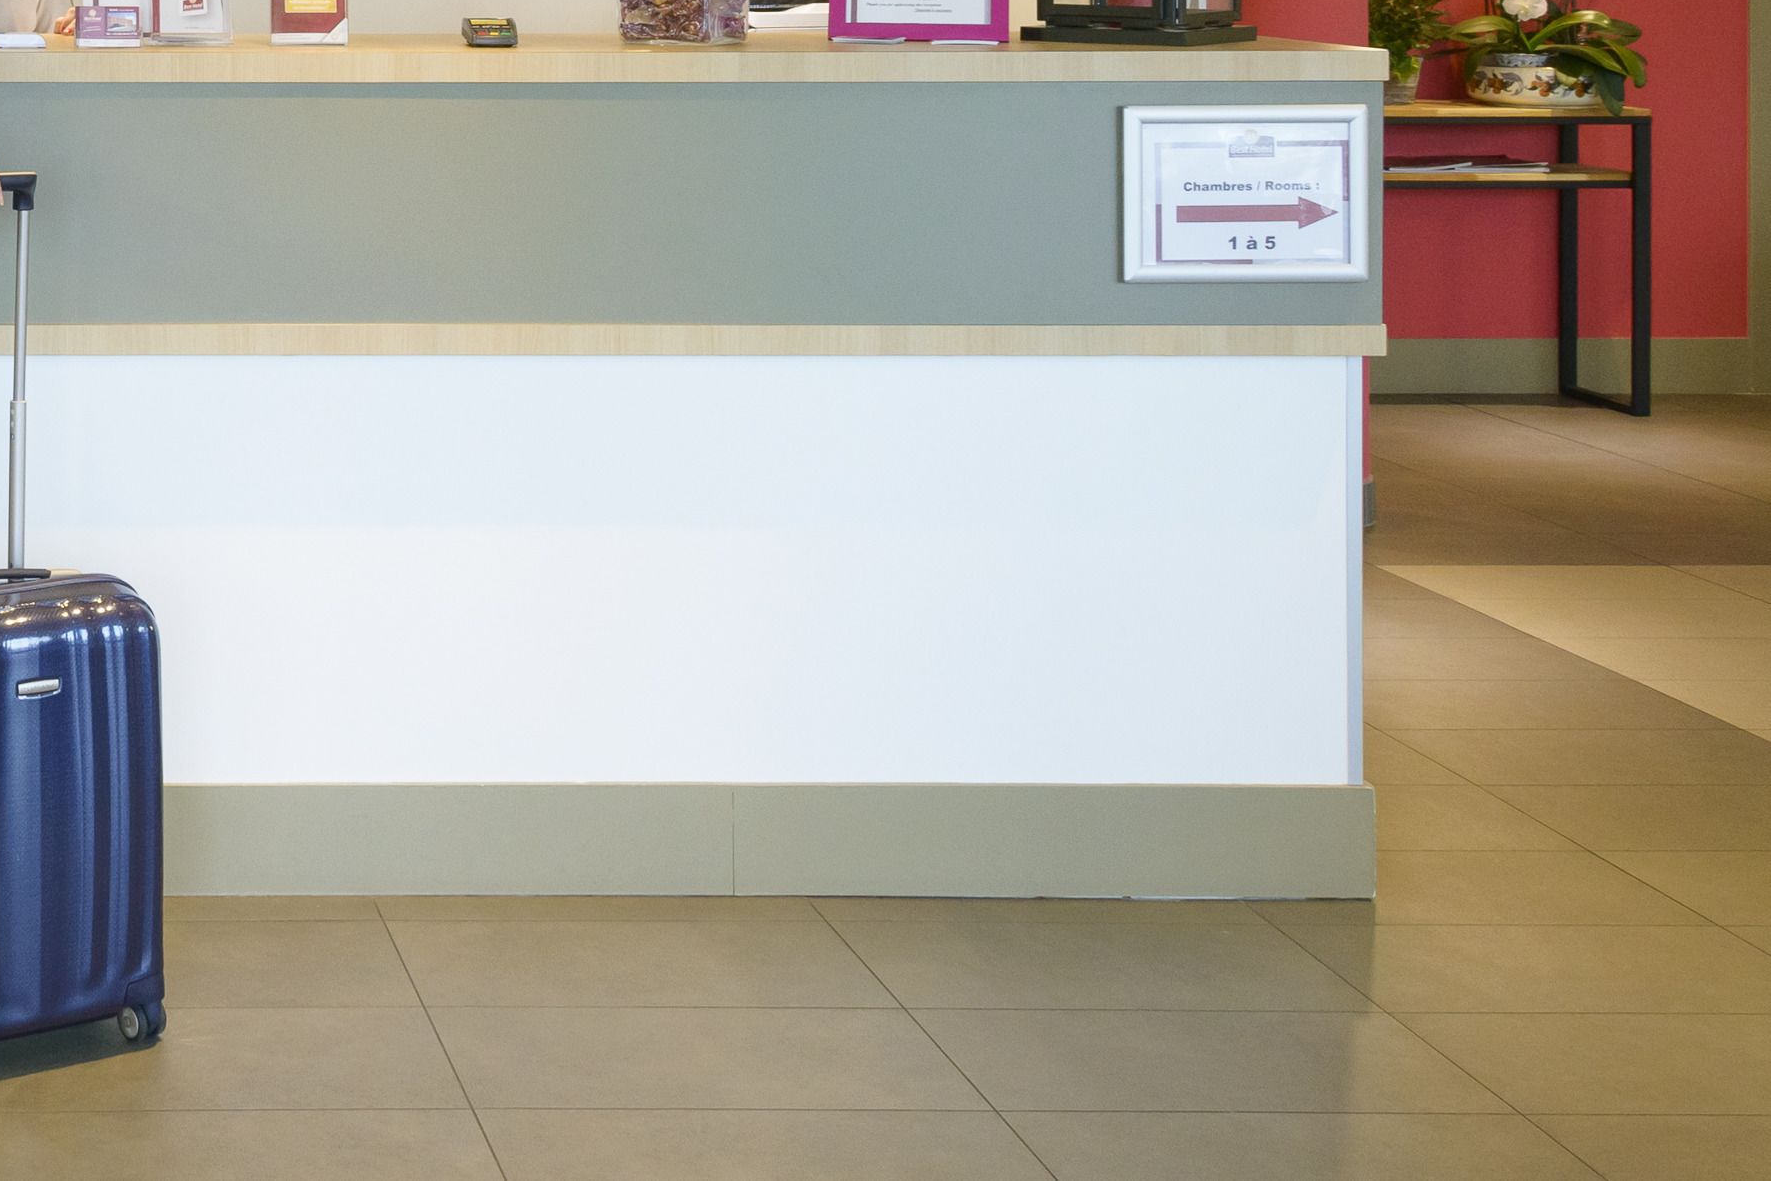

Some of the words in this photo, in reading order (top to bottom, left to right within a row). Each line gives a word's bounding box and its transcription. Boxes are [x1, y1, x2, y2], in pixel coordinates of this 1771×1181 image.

[1183, 181, 1253, 192] Chambres
[1265, 181, 1311, 191] Rooms
[1228, 236, 1237, 250] 1
[1246, 235, 1258, 250] à
[1264, 236, 1276, 250] 5
